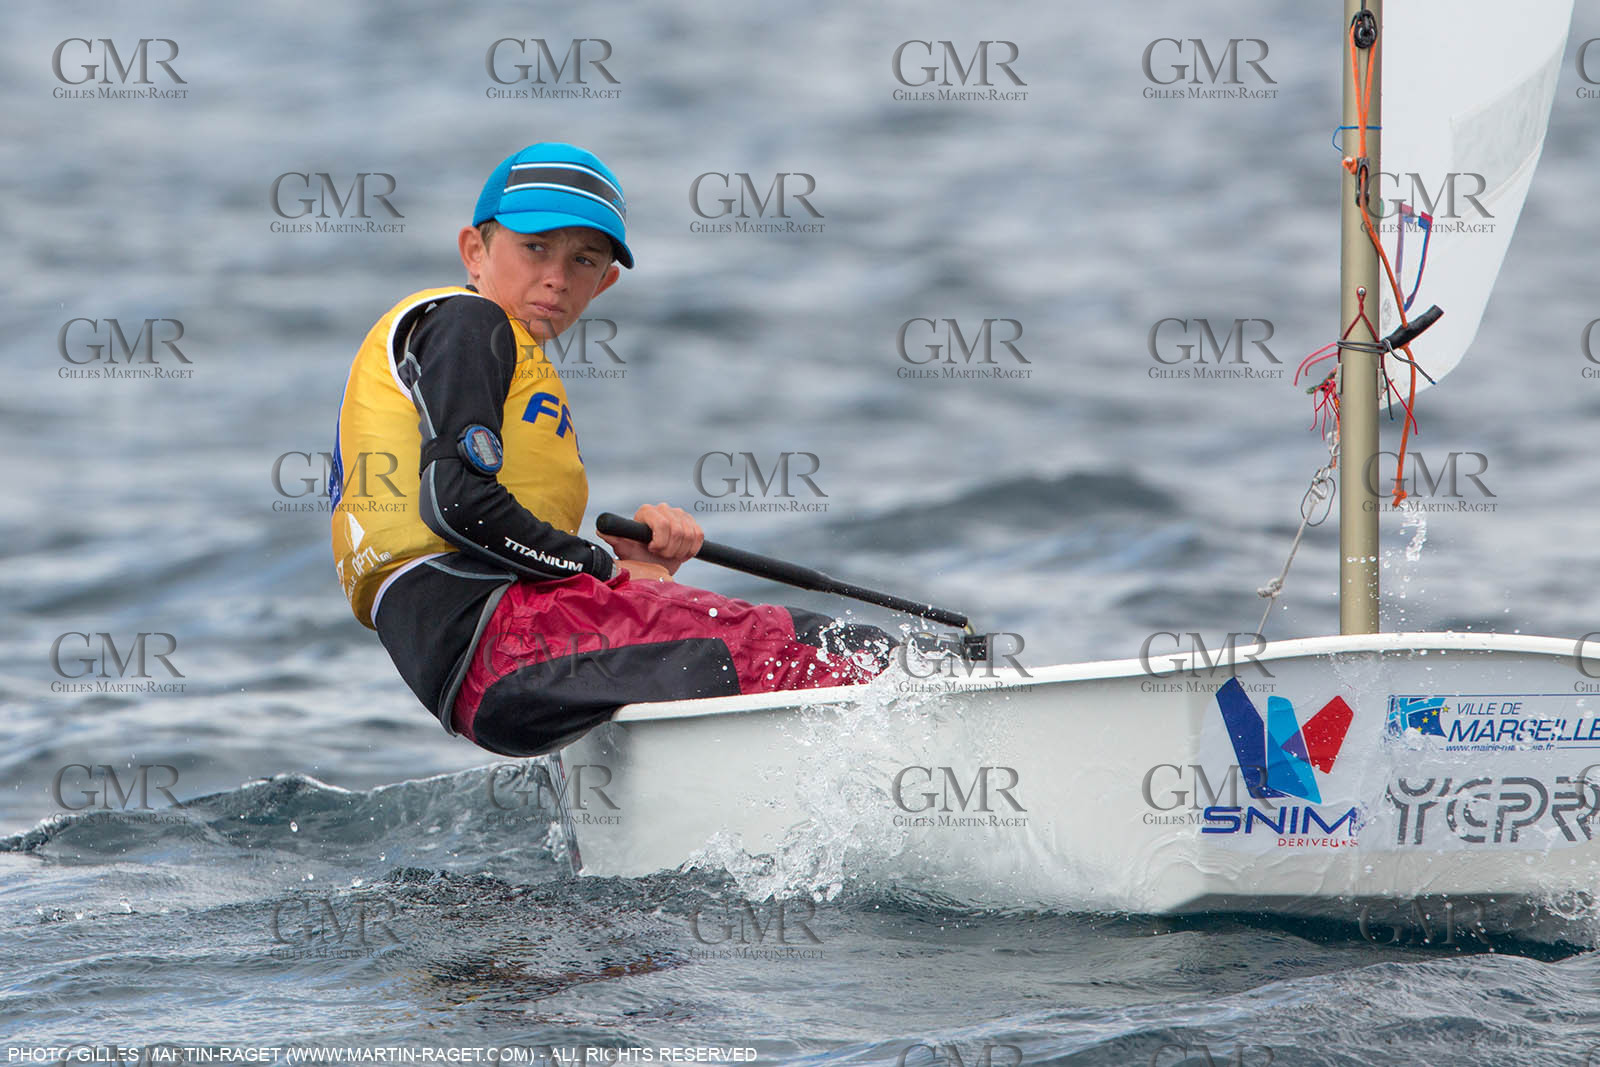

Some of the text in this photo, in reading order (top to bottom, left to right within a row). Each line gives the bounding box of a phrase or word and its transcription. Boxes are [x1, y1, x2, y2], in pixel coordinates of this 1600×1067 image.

[504, 536, 584, 572] TITANIUM
[1456, 702, 1523, 715] VILLE DE
[1201, 806, 1358, 836] SNIM
